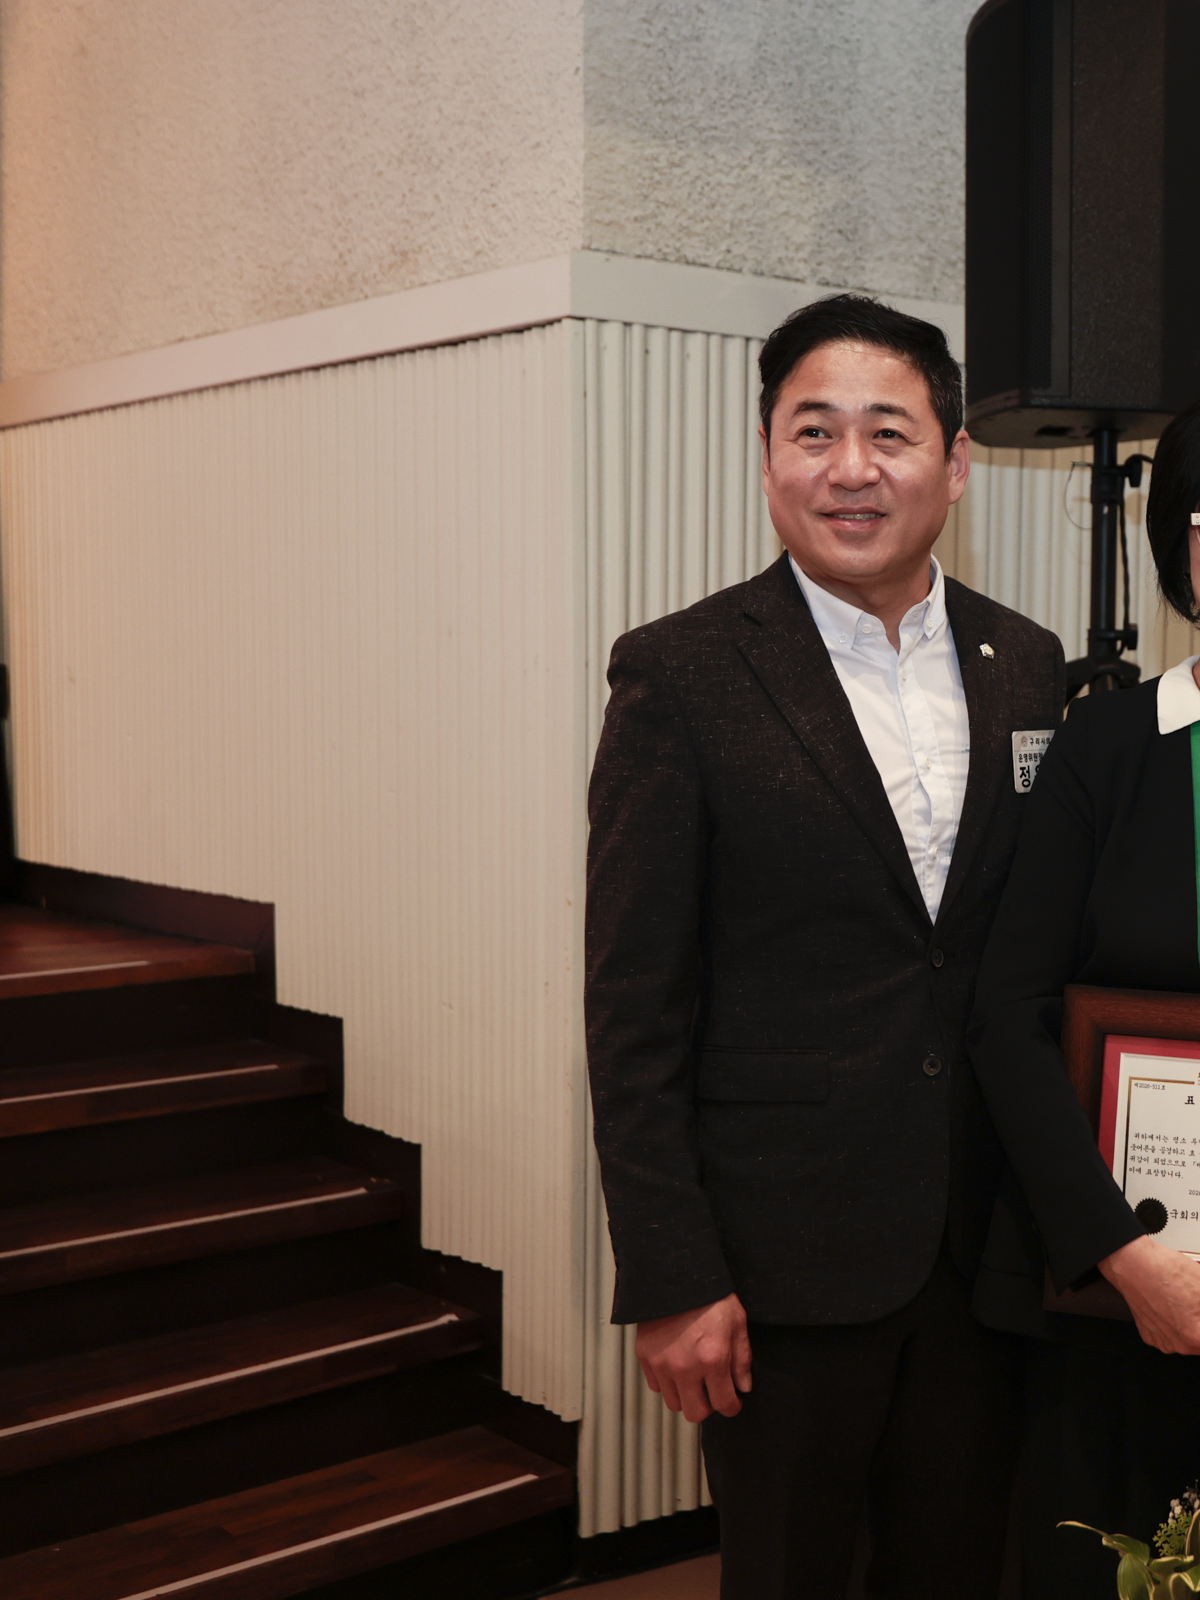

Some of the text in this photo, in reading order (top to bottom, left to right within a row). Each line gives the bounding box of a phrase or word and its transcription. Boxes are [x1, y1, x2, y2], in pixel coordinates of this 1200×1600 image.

[1030, 738, 1050, 746] 구리시의
[1160, 1146, 1185, 1155] 공경하고
[1130, 1155, 1149, 1164] 귀감이
[1146, 1168, 1184, 1179] 표창합니다.
